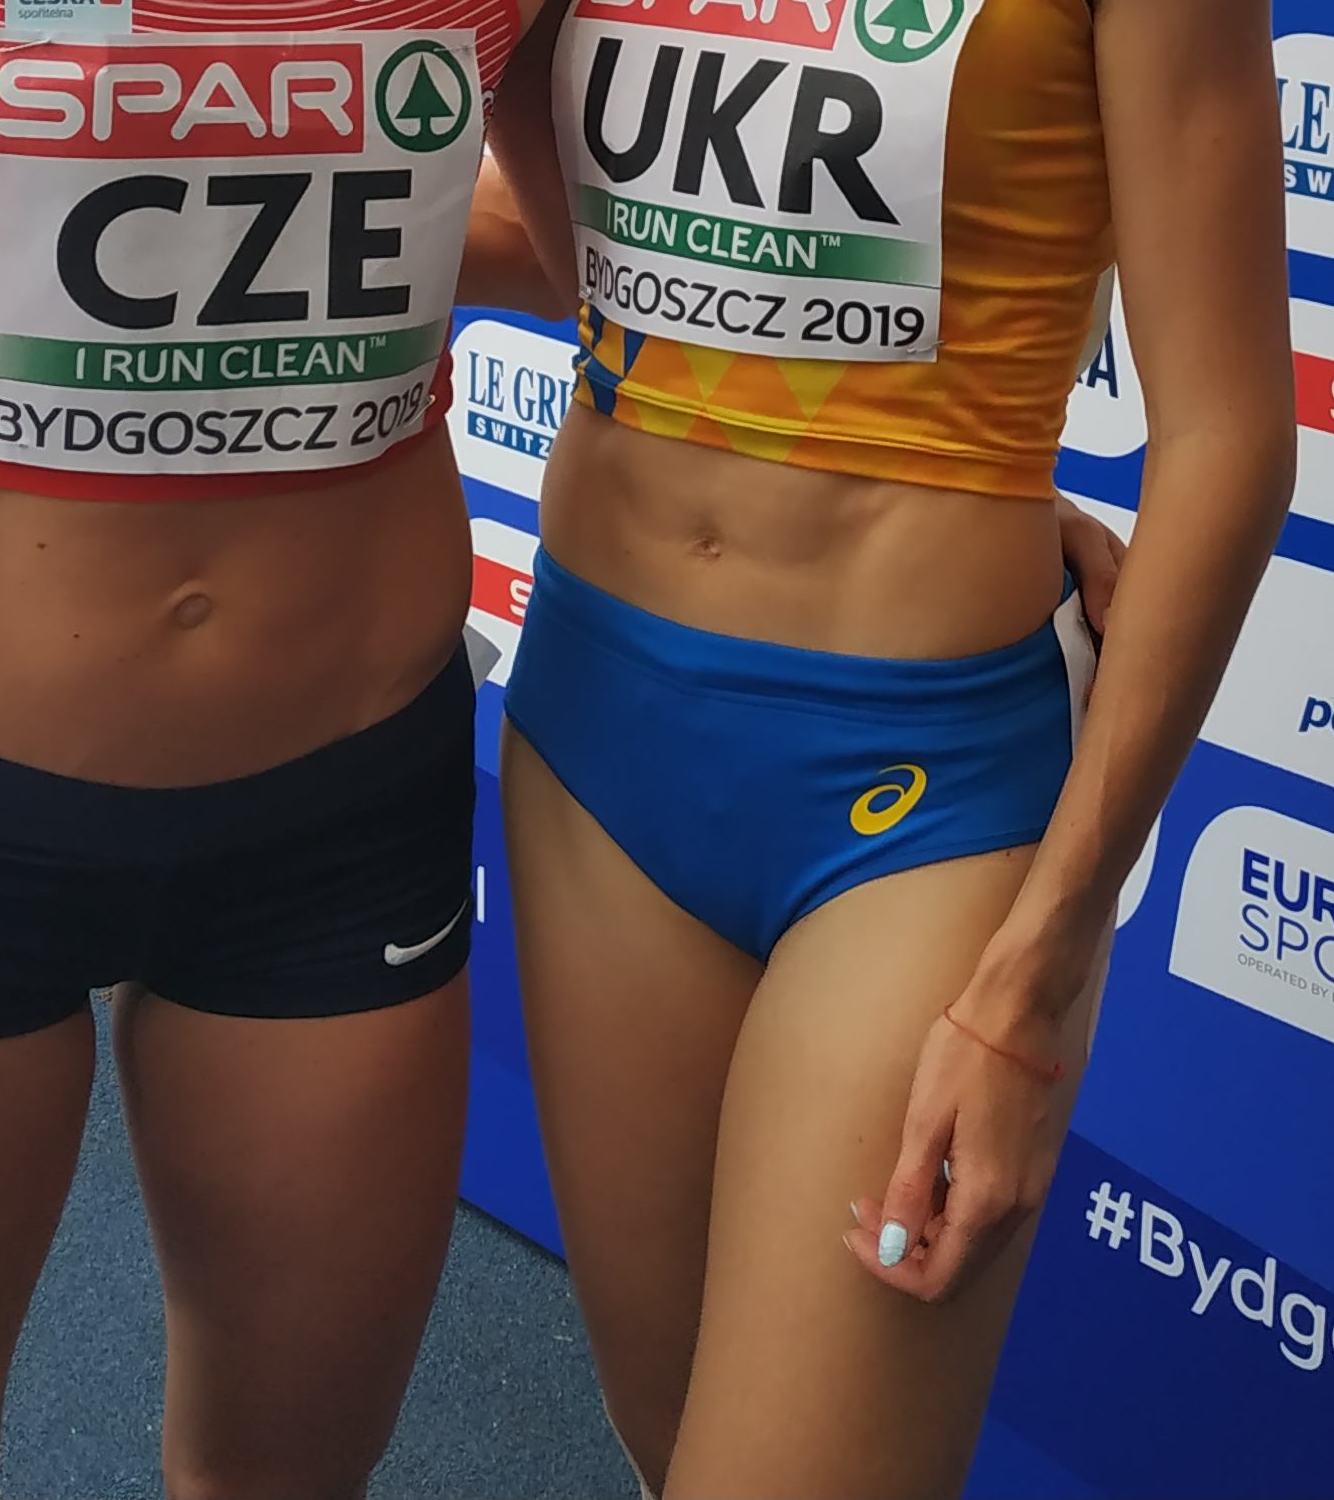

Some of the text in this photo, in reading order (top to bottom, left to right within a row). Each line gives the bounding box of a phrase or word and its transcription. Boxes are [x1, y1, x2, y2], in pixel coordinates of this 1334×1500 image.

[583, 37, 901, 226] UKR
[56, 169, 412, 330] CZE
[614, 203, 677, 248] RUN
[586, 246, 925, 349] BYDGOSZCZ 2019
[75, 347, 86, 380] I
[104, 347, 205, 384] RUN
[469, 351, 505, 408] LE
[352, 381, 425, 447] 2019
[1237, 952, 1308, 993] OPERATED
[1311, 981, 1329, 1000] BY
